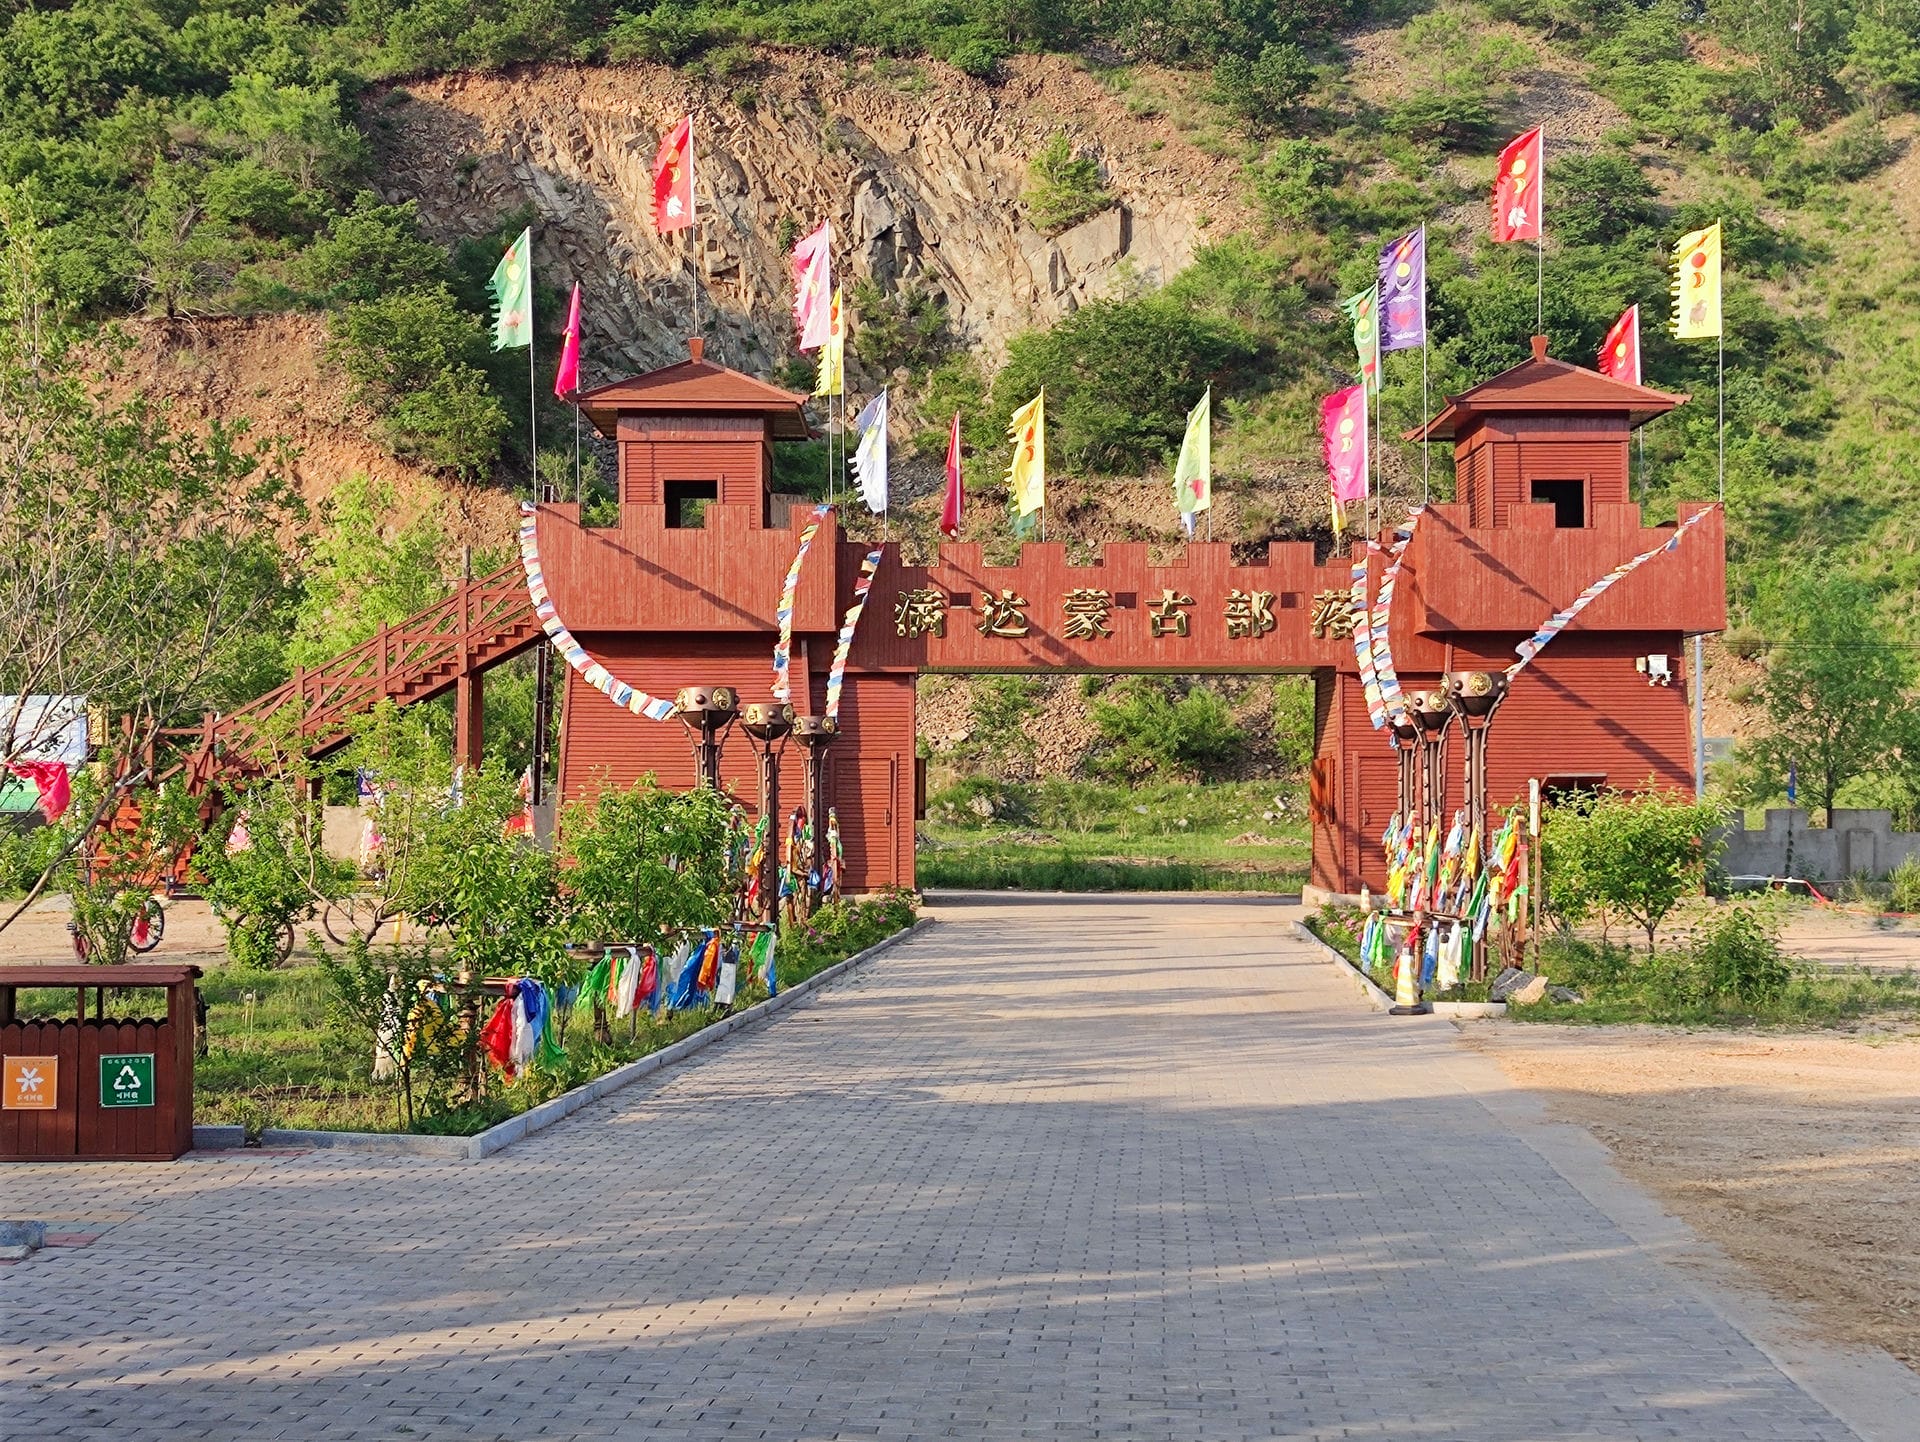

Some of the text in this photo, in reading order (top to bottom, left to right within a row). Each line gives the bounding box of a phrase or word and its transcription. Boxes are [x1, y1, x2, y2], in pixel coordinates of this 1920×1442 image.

[894, 588, 1353, 640] 满达蒙古部落
